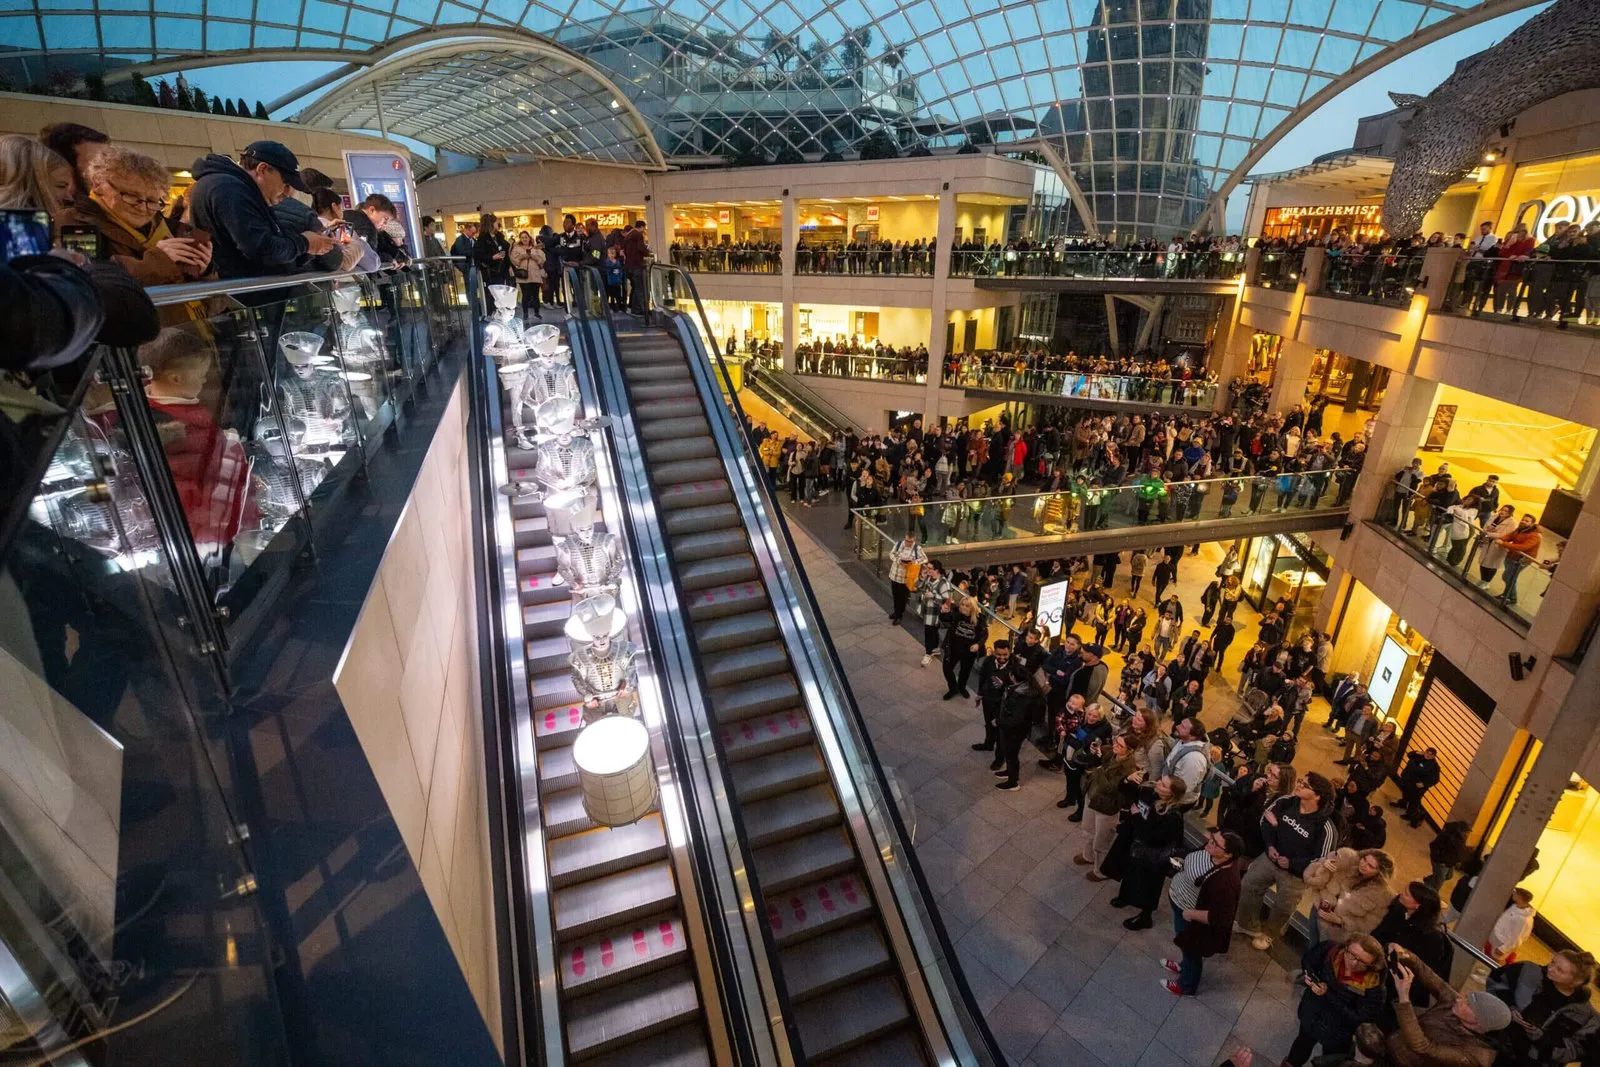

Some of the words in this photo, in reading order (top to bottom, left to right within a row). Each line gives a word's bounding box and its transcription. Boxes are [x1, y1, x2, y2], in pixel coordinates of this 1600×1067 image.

[1281, 207, 1299, 216] THE
[1300, 205, 1379, 216] ALCHEMIST
[1282, 815, 1310, 838] adidas
